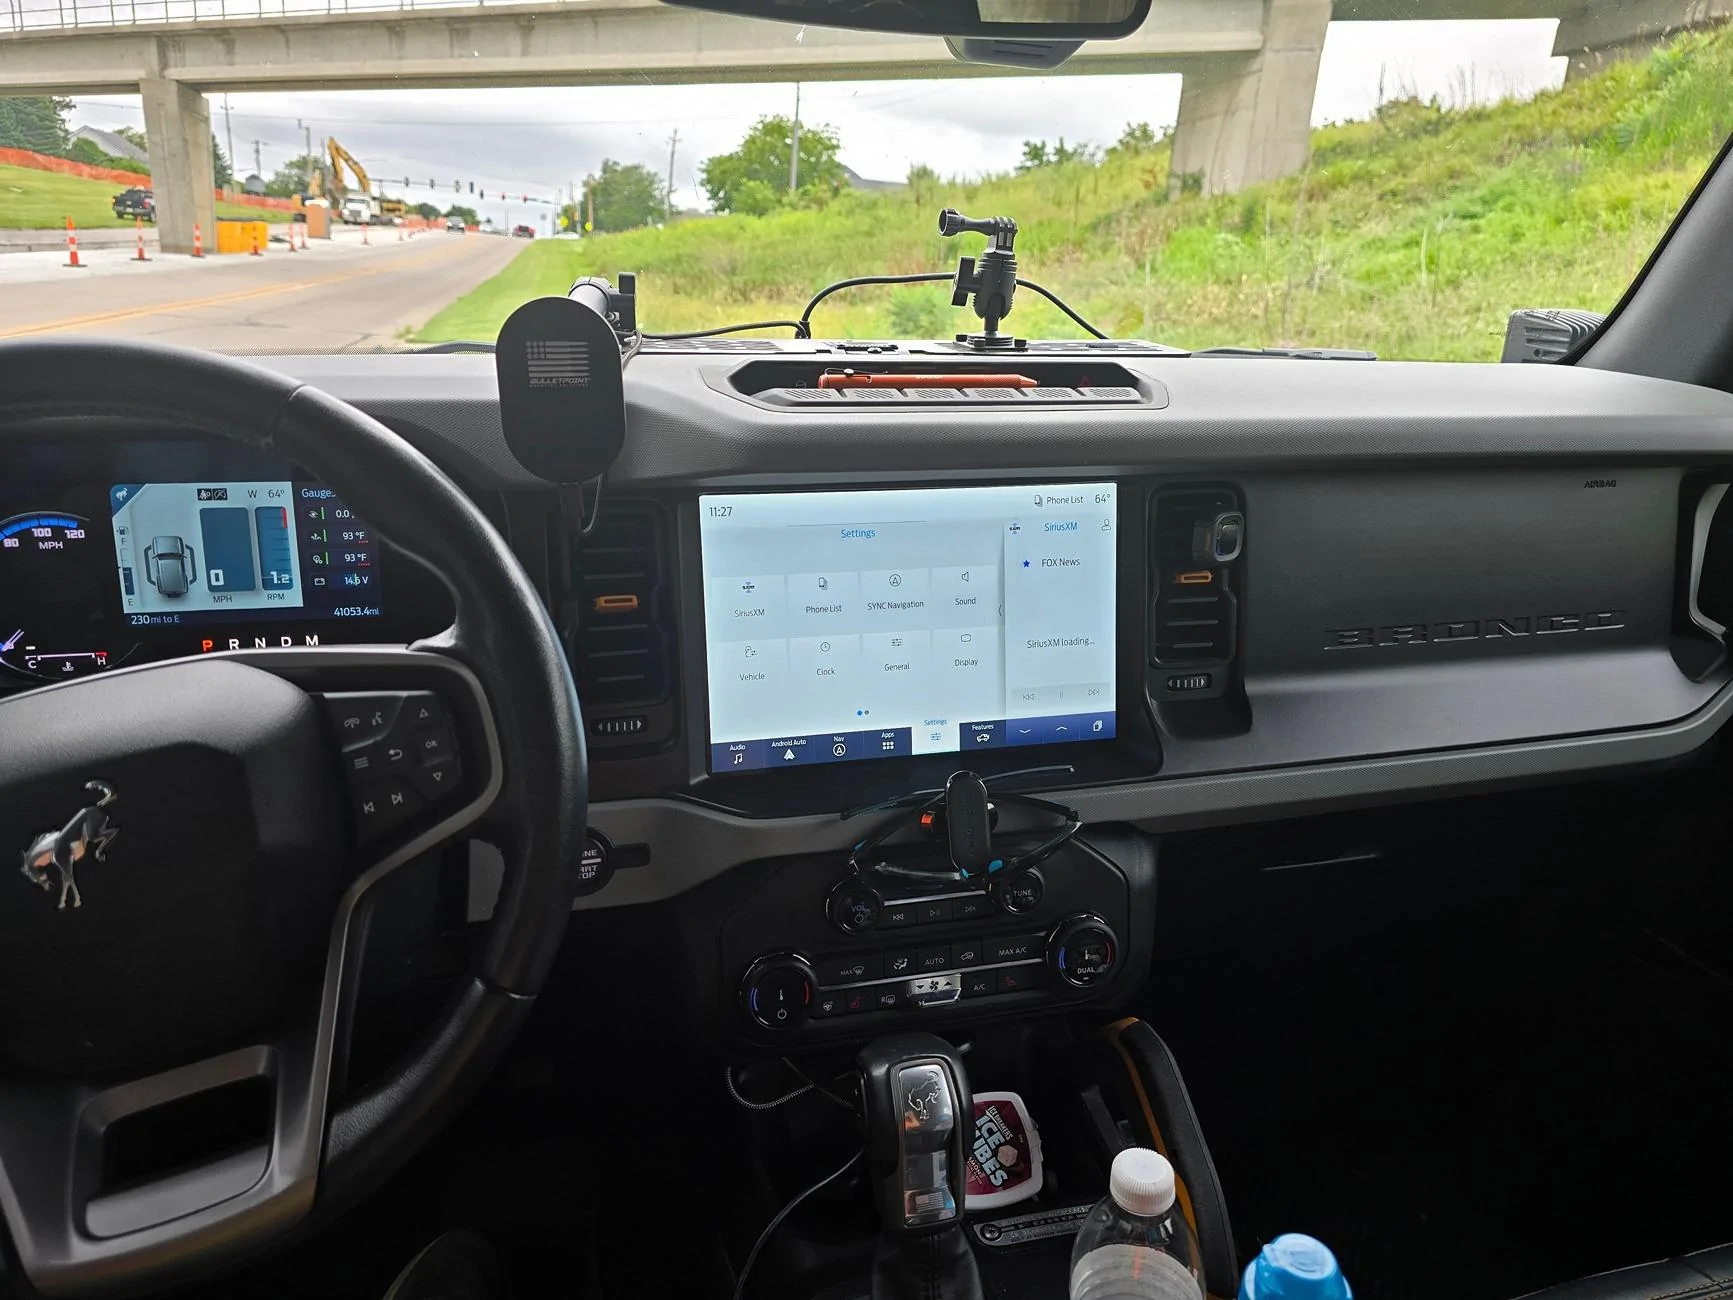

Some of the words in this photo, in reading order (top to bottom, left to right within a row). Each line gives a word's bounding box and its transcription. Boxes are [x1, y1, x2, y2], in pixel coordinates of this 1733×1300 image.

[1583, 480, 1617, 489] AIRBAG
[247, 490, 257, 498] W
[1046, 496, 1070, 504] Phone
[1071, 496, 1084, 504] List
[1094, 494, 1110, 504] 64°
[709, 506, 732, 517] 11:27
[1044, 522, 1078, 532] SiriusXM
[32, 528, 52, 537] 100
[64, 530, 85, 539] 120
[342, 532, 354, 540] 93
[840, 528, 876, 539] Settings
[3, 538, 19, 548] 80
[38, 541, 64, 550] MPH
[344, 554, 356, 562] 93
[1042, 558, 1058, 567] FOX
[1060, 558, 1080, 566] News
[210, 569, 224, 586] 0
[270, 571, 290, 584] 1.2
[213, 595, 232, 604] MPH
[955, 597, 976, 606] Sound
[805, 605, 828, 614] Phone
[830, 604, 842, 613] List
[867, 602, 887, 610] SYNC
[888, 600, 924, 610] Navigation
[734, 608, 765, 618] SiriusXM
[202, 640, 213, 652] P
[229, 638, 239, 650] R
[255, 637, 266, 648] N
[281, 636, 292, 647] D
[305, 635, 318, 646] M
[1026, 638, 1060, 648] SiriusXM
[28, 660, 37, 669] C
[96, 657, 106, 666] H
[954, 658, 978, 668] Display
[884, 663, 910, 671] General
[740, 672, 765, 681] Vehicle
[816, 668, 836, 676] Clock
[924, 719, 948, 727] Settings
[881, 731, 895, 740] Apps
[425, 740, 438, 749] OK
[925, 957, 944, 966] AUTO
[976, 1115, 1006, 1150] ICE
[973, 1126, 1008, 1186] UBES
